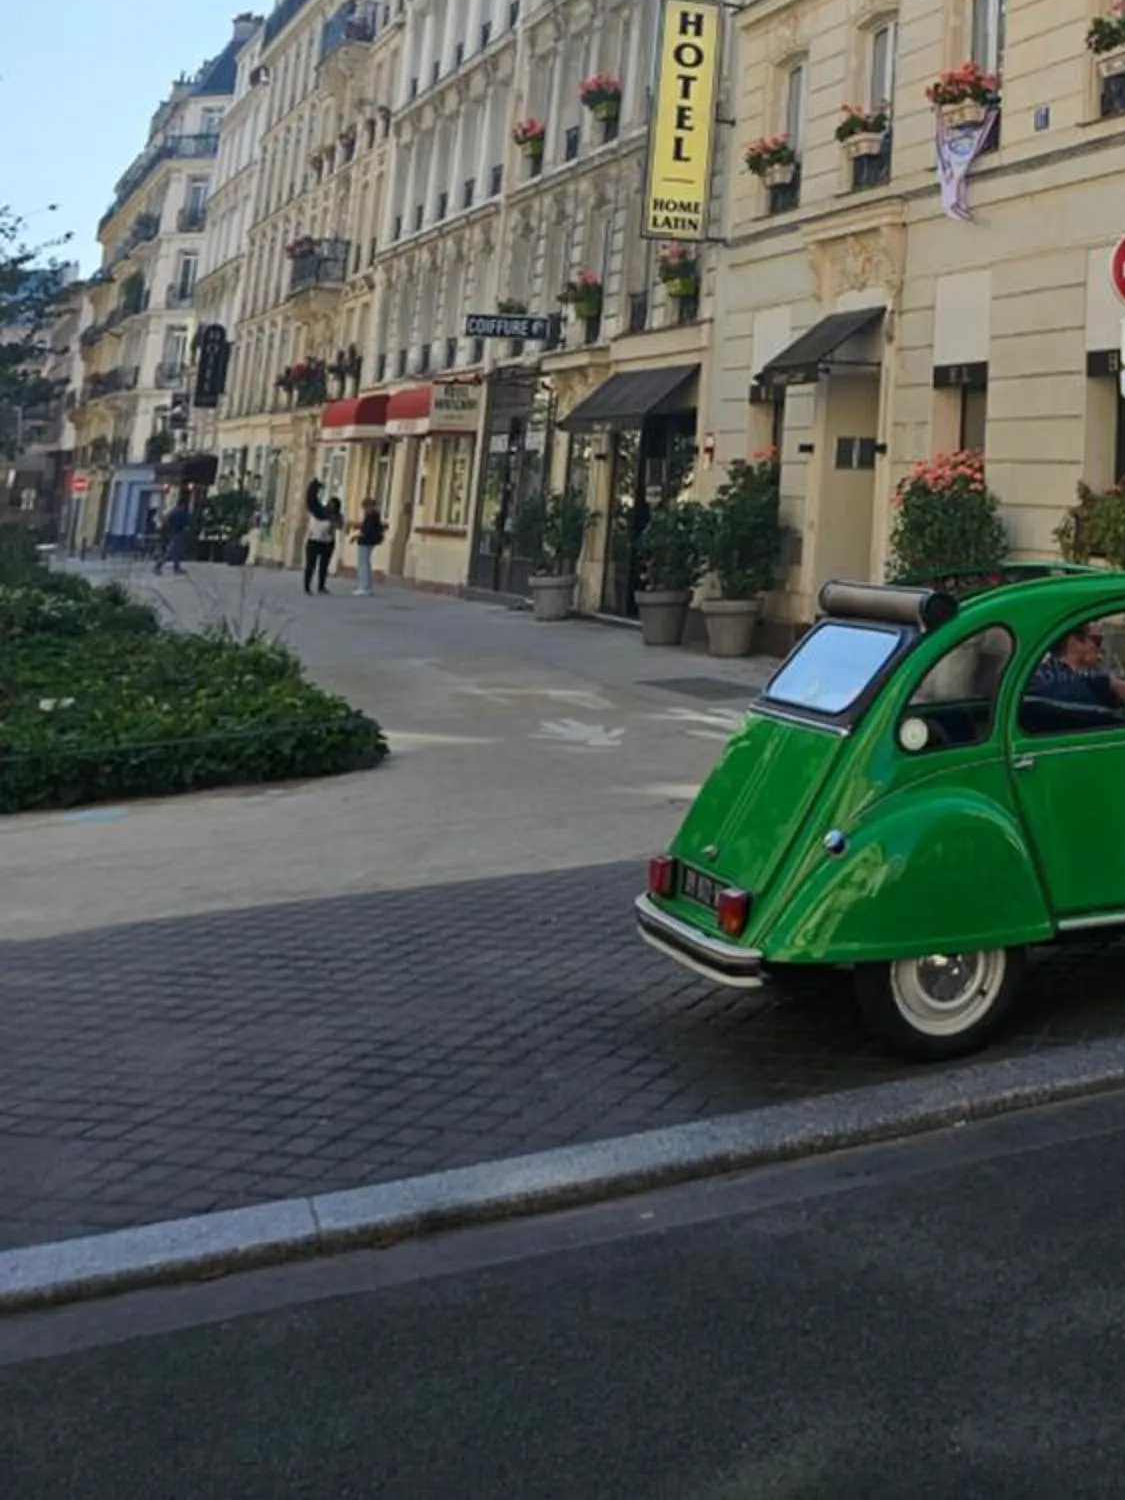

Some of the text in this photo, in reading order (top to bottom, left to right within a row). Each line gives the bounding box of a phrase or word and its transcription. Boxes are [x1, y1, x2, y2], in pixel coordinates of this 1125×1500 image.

[673, 11, 704, 162] HOTEL
[652, 197, 700, 213] HOME
[652, 215, 698, 231] LATIN
[469, 317, 529, 336] COIFFURE
